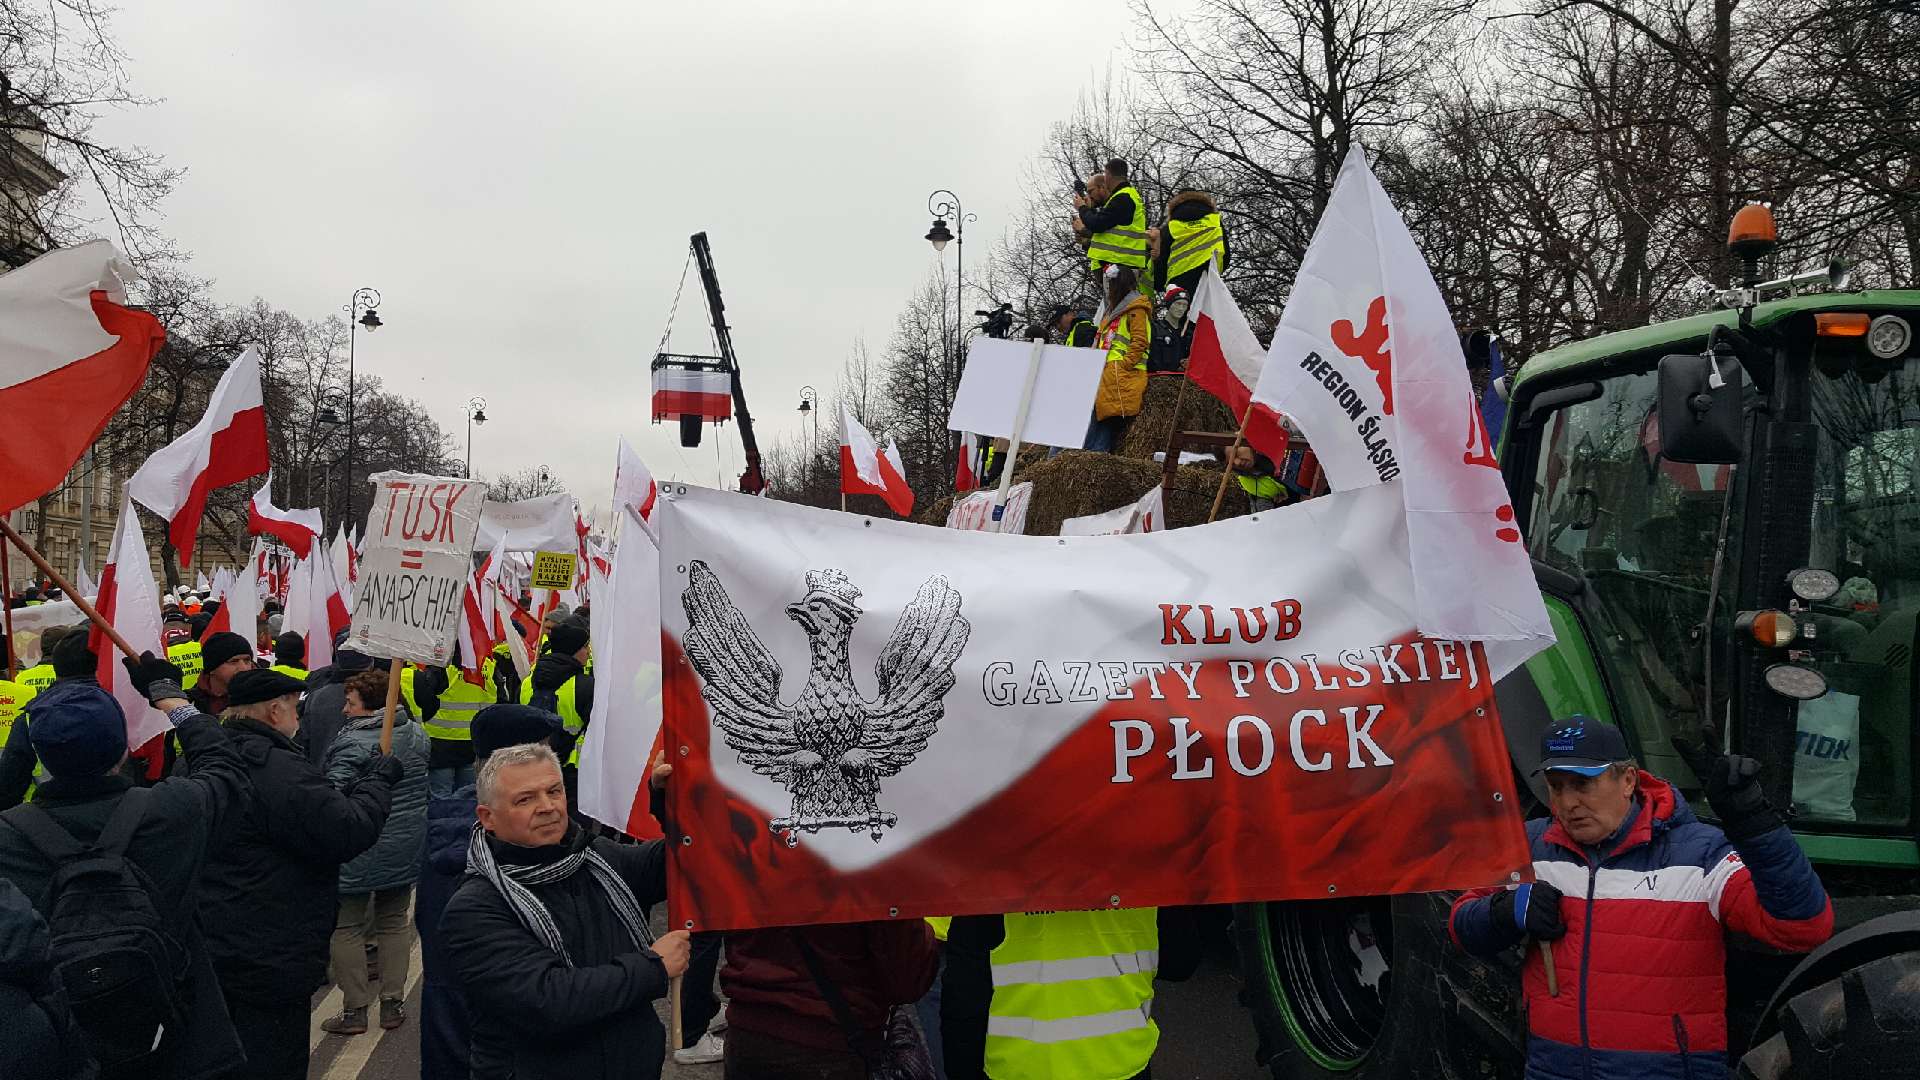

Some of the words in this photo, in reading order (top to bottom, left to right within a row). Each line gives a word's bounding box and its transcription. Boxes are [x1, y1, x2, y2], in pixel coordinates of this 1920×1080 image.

[1299, 351, 1368, 422] REGION
[384, 482, 468, 543] TUSK
[1157, 598, 1303, 646] KLUB
[982, 660, 1204, 706] GAZETY
[1228, 640, 1479, 699] POLSKIEJ
[1109, 704, 1396, 784] PŁOCK
